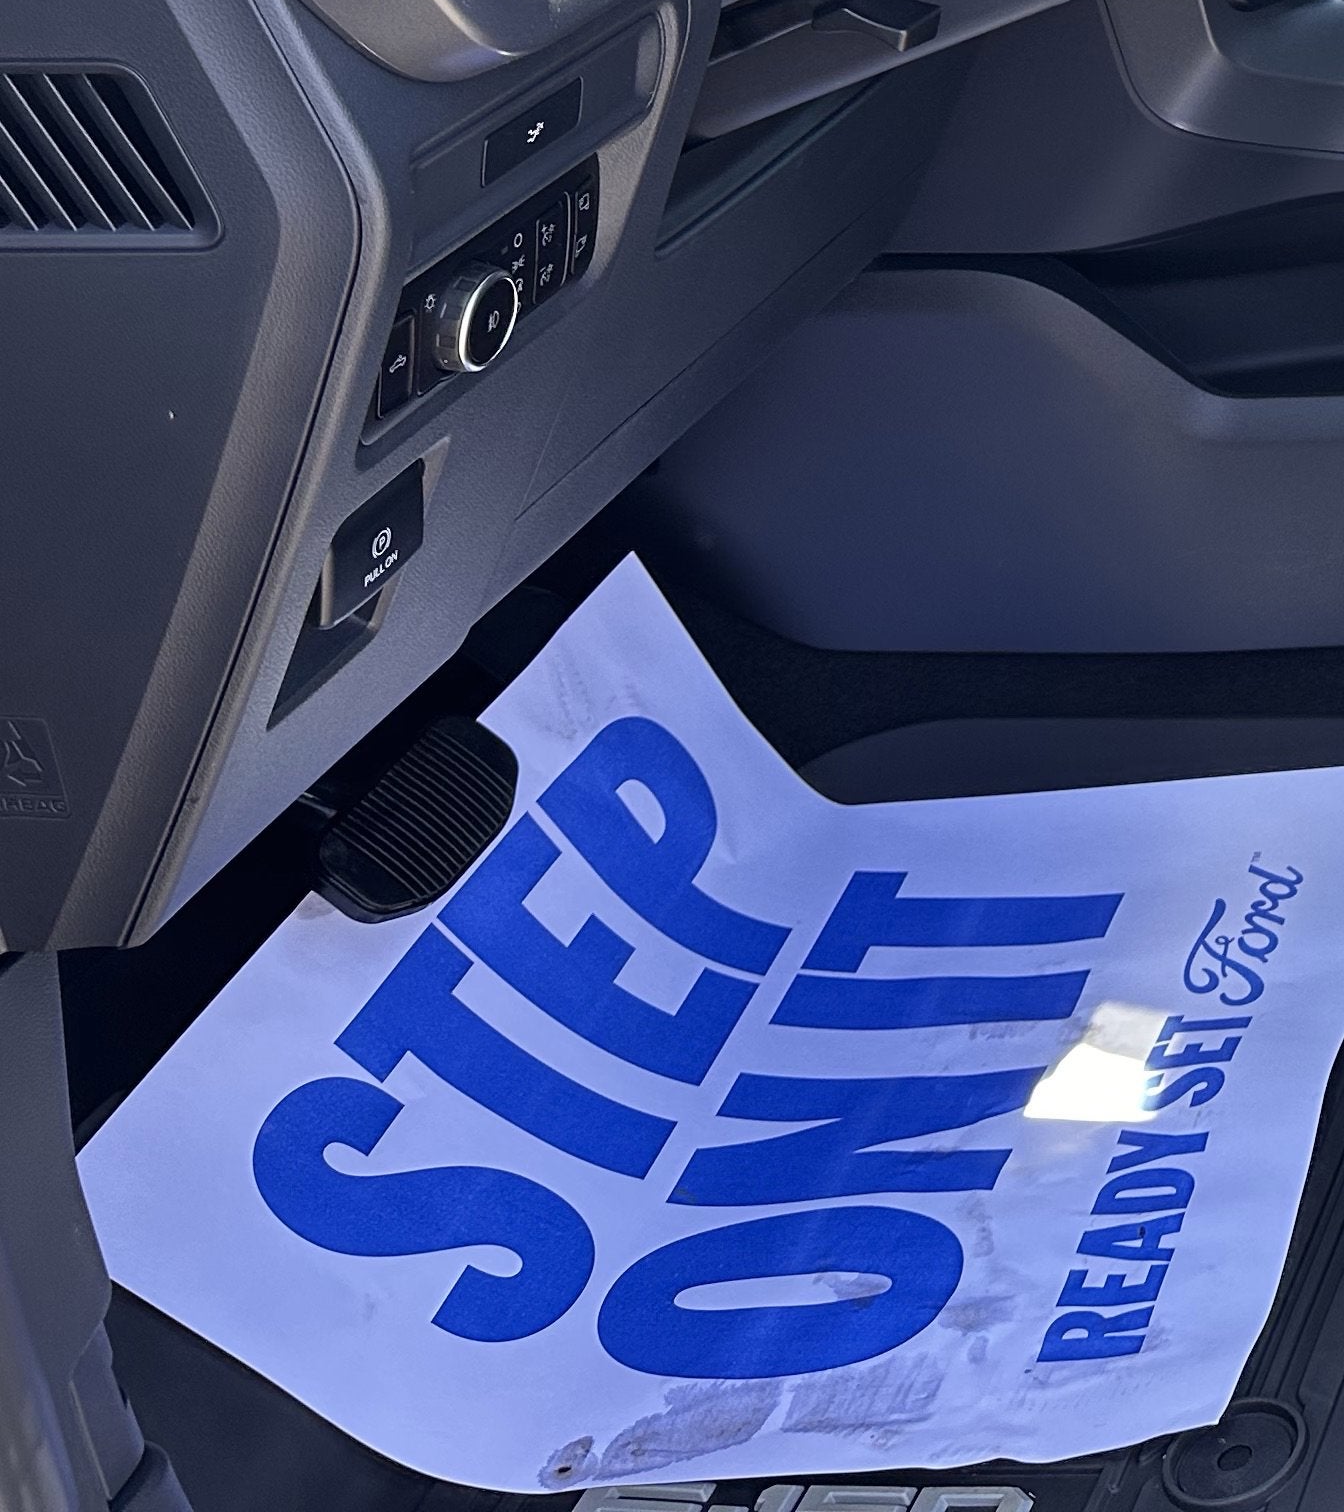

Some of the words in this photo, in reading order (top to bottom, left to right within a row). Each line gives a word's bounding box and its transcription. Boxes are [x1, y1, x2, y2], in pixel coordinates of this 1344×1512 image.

[364, 563, 385, 587] PULL
[384, 549, 399, 568] ON
[769, 870, 1125, 1031] IT
[1183, 865, 1304, 1007] Ford
[252, 716, 792, 1344] STEP
[1140, 1014, 1253, 1113] SET
[598, 1065, 1048, 1380] ON
[1036, 1128, 1210, 1363] READY
